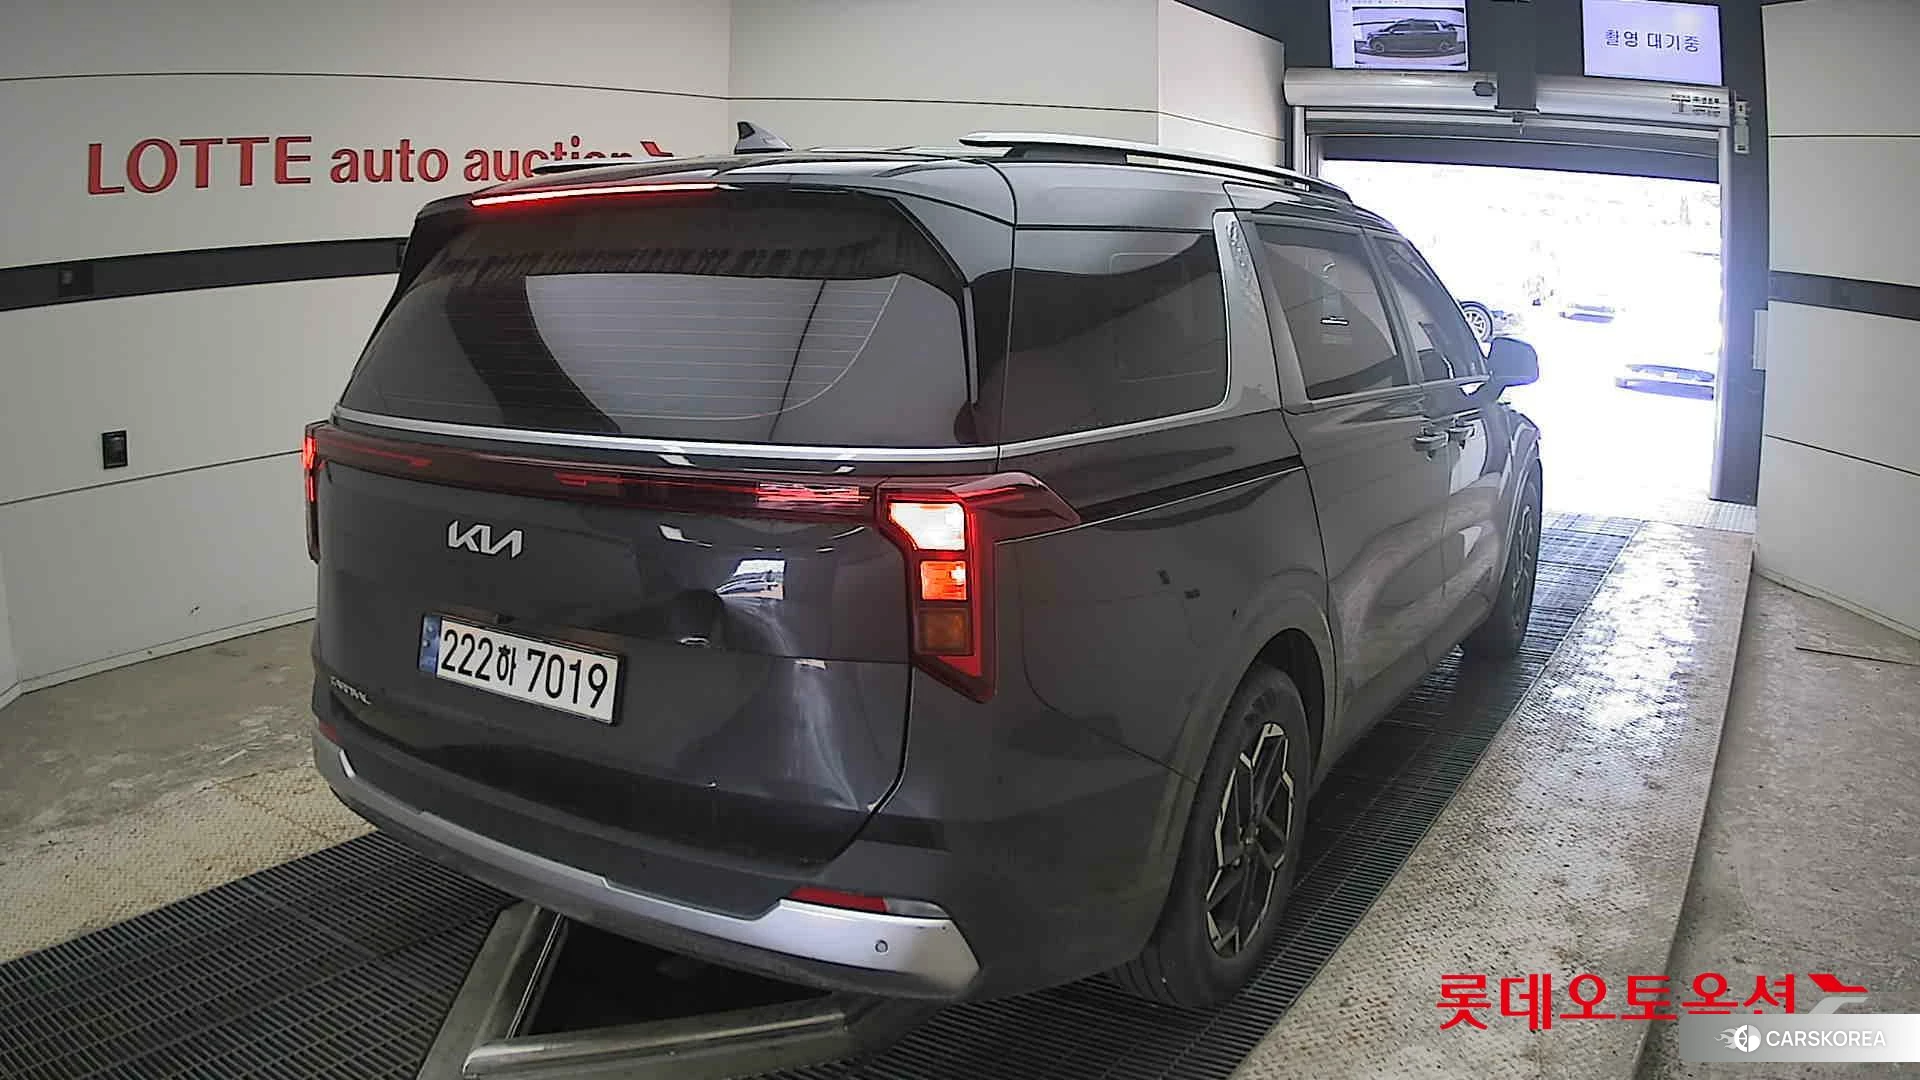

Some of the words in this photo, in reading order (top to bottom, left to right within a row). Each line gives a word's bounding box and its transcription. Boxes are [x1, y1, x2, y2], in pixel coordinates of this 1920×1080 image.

[1647, 33, 1699, 52] 대기중
[88, 135, 312, 195] LOTTE
[329, 138, 449, 183] auto
[441, 629, 517, 687] 222하
[527, 648, 608, 709] 7019
